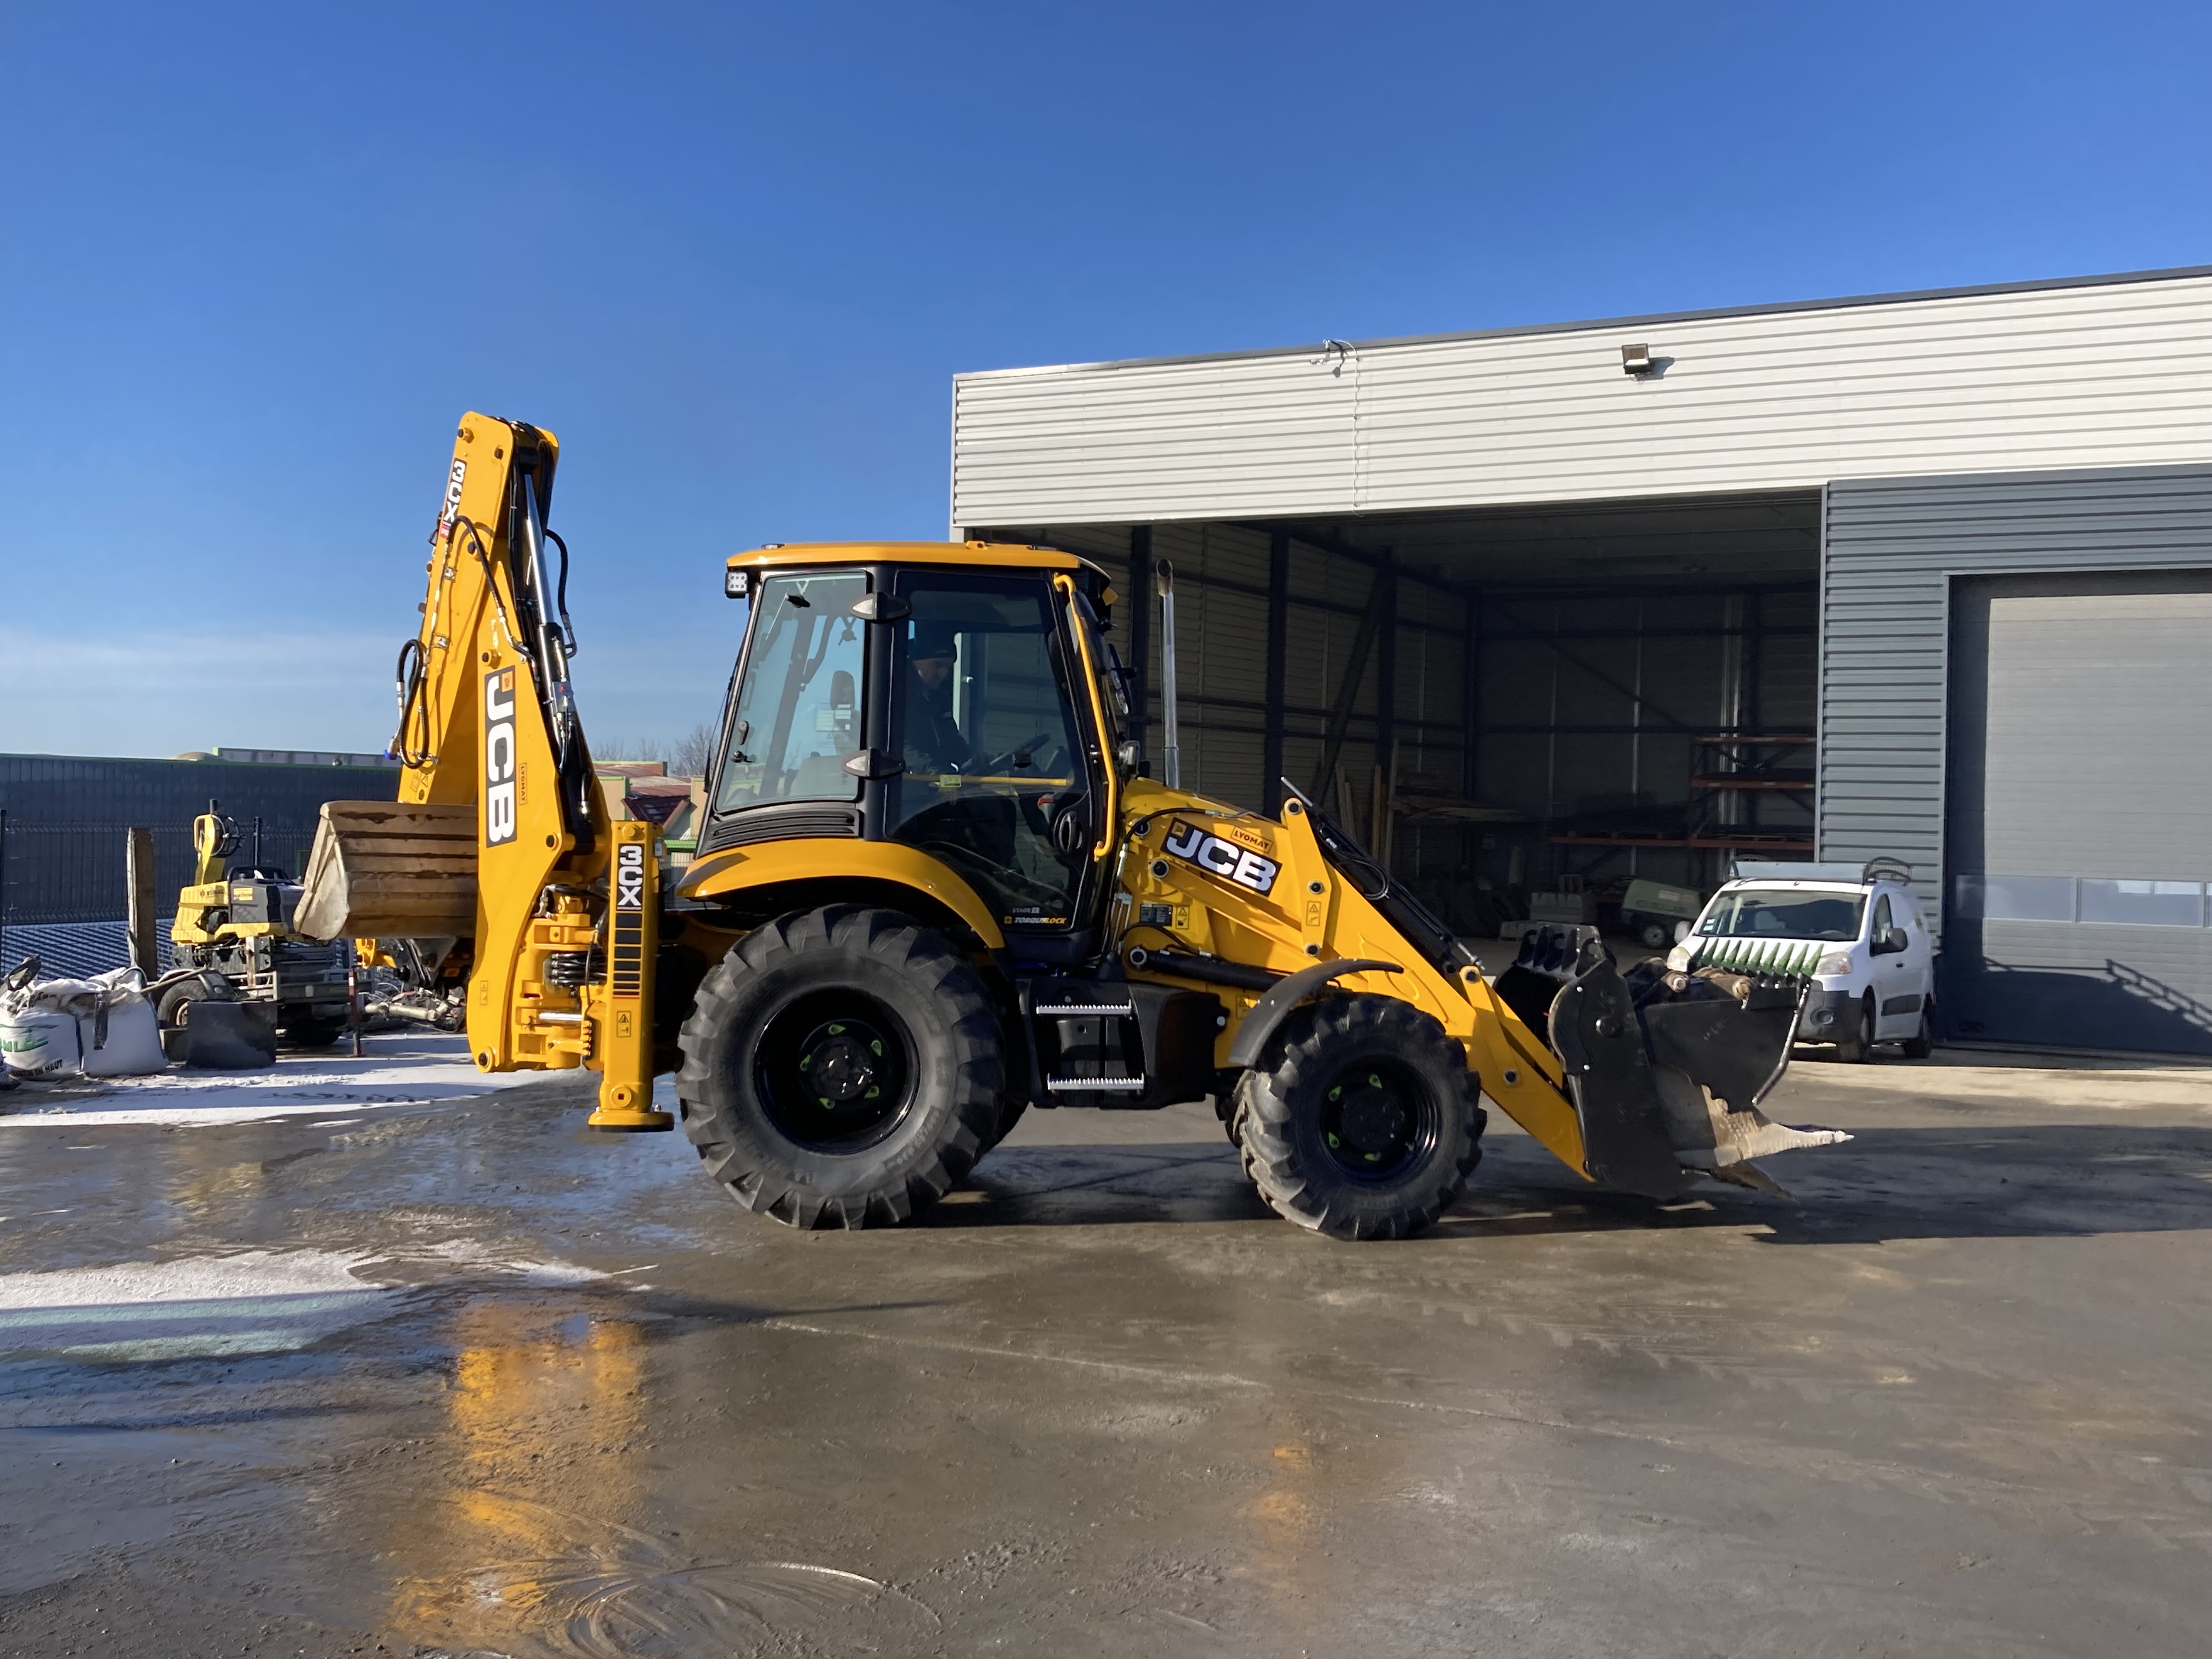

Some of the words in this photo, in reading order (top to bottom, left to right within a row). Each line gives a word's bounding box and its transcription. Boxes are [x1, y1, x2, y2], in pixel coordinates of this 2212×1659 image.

[444, 460, 466, 523] 3CX
[487, 675, 515, 843] JCB
[1166, 829, 1277, 891] JCB
[1234, 830, 1269, 850] LYOMAT
[618, 845, 643, 906] 3CX
[45, 1058, 63, 1073] HAUT
